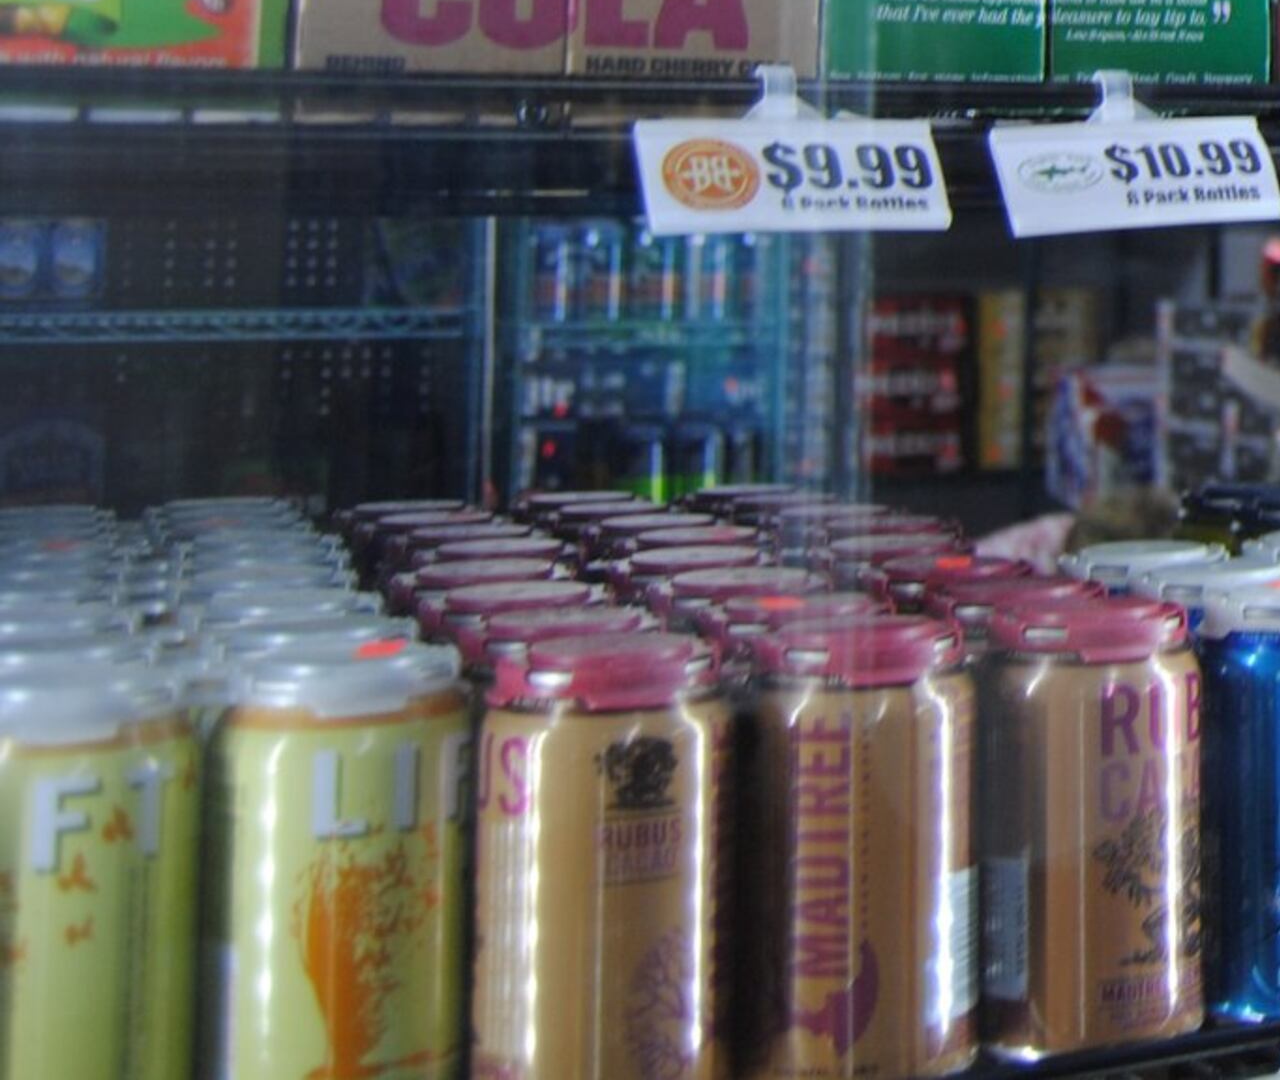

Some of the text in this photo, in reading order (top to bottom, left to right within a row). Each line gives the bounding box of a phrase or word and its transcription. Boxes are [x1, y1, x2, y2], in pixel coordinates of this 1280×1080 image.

[876, 3, 911, 21] that
[941, 8, 977, 25] ever
[978, 6, 1009, 26] had
[1009, 8, 1034, 26] the
[1114, 9, 1132, 24] to
[761, 139, 934, 196] $9.99
[1103, 137, 1263, 186] $10.99
[799, 195, 851, 211] Pack
[856, 194, 930, 211] Bottles
[1143, 185, 1189, 205] Pack
[1193, 183, 1261, 203] Bottles
